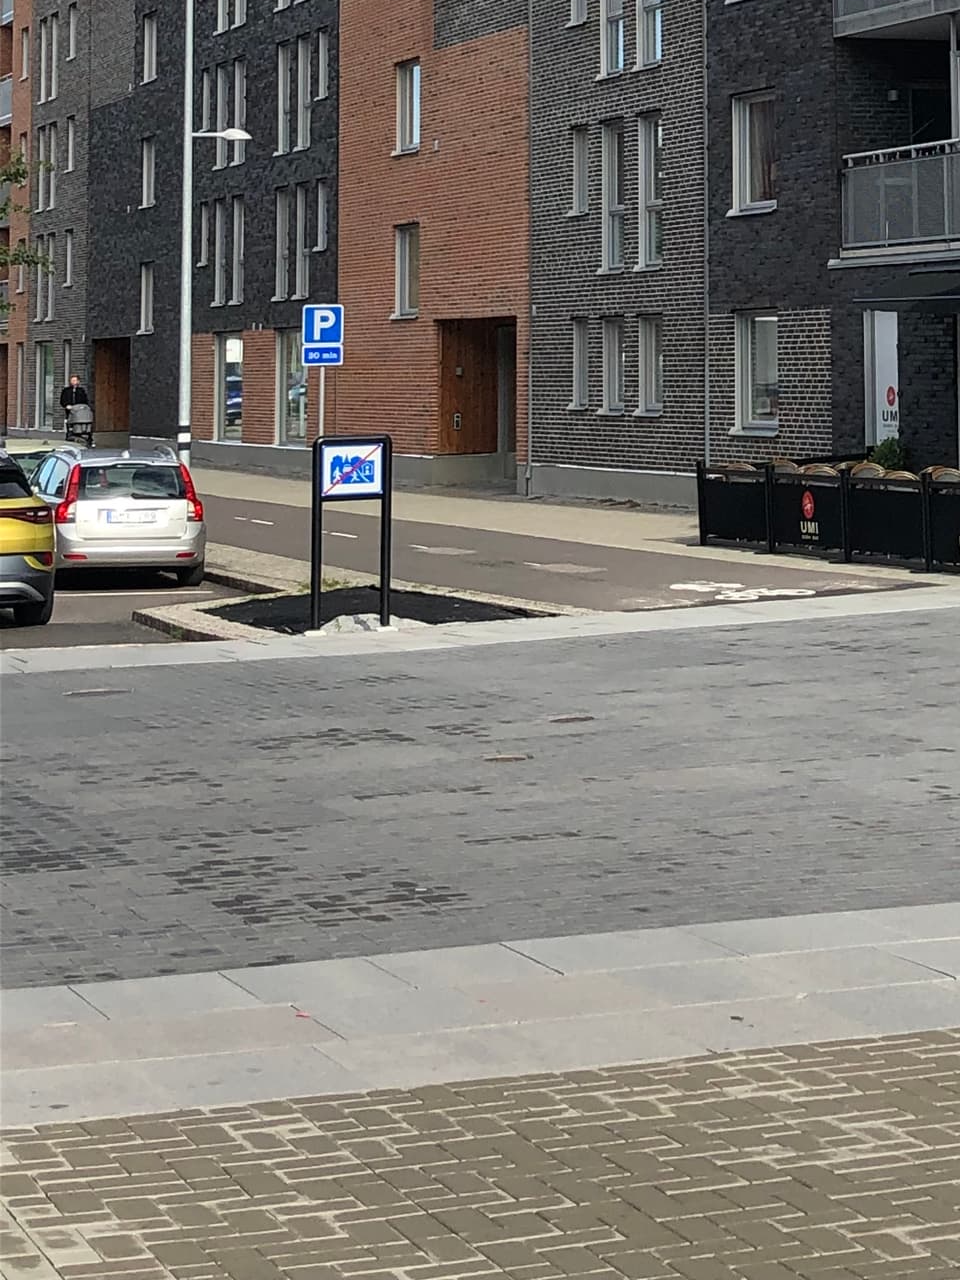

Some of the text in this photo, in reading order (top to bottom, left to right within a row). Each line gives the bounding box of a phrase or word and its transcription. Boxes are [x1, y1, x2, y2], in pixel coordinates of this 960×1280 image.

[313, 309, 336, 341] P
[322, 351, 338, 359] min
[800, 520, 819, 534] UMI
